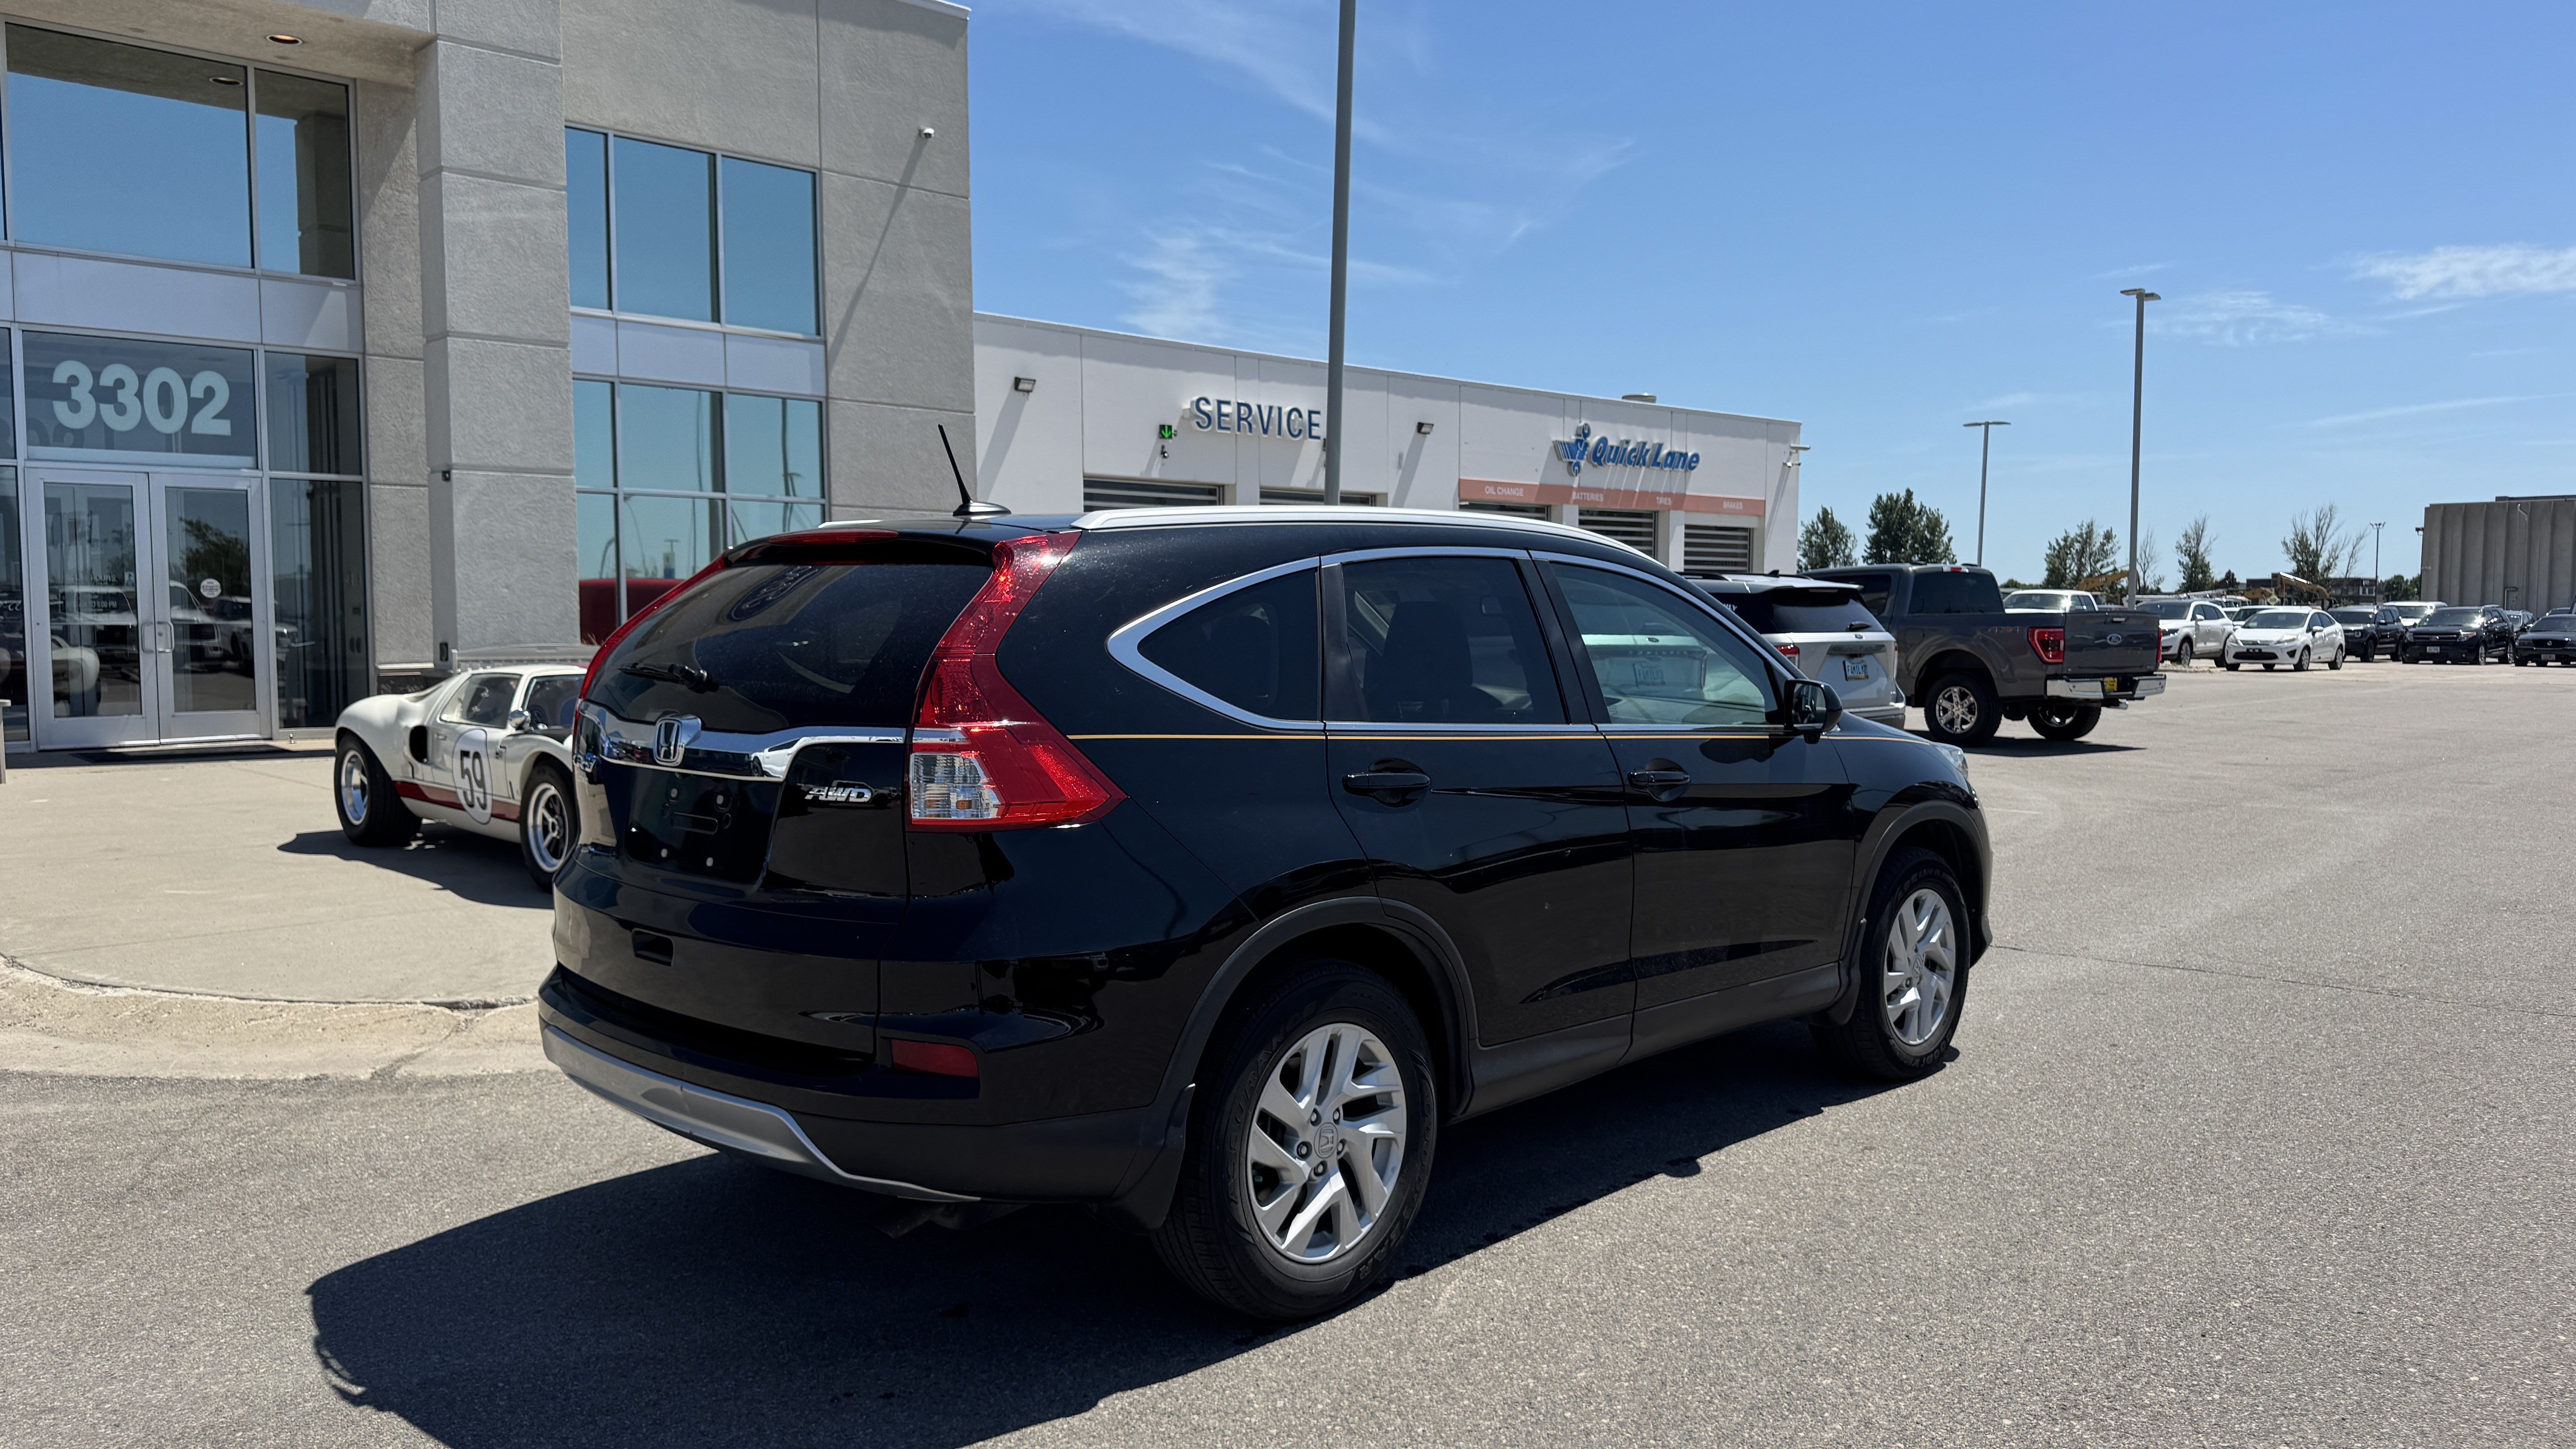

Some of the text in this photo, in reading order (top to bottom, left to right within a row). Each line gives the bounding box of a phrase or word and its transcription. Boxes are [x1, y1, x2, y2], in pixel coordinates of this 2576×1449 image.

[52, 360, 231, 437] 3302
[1195, 396, 1321, 440] SERVICE
[1592, 436, 1700, 471] Quick Lane
[1485, 485, 1524, 497] OIL CHANGE
[1572, 490, 1604, 502] BATTERIES
[1656, 497, 1671, 506] TIRES
[1723, 501, 1743, 510] BRAKES
[460, 750, 488, 810] 59
[805, 786, 872, 803] AWD
